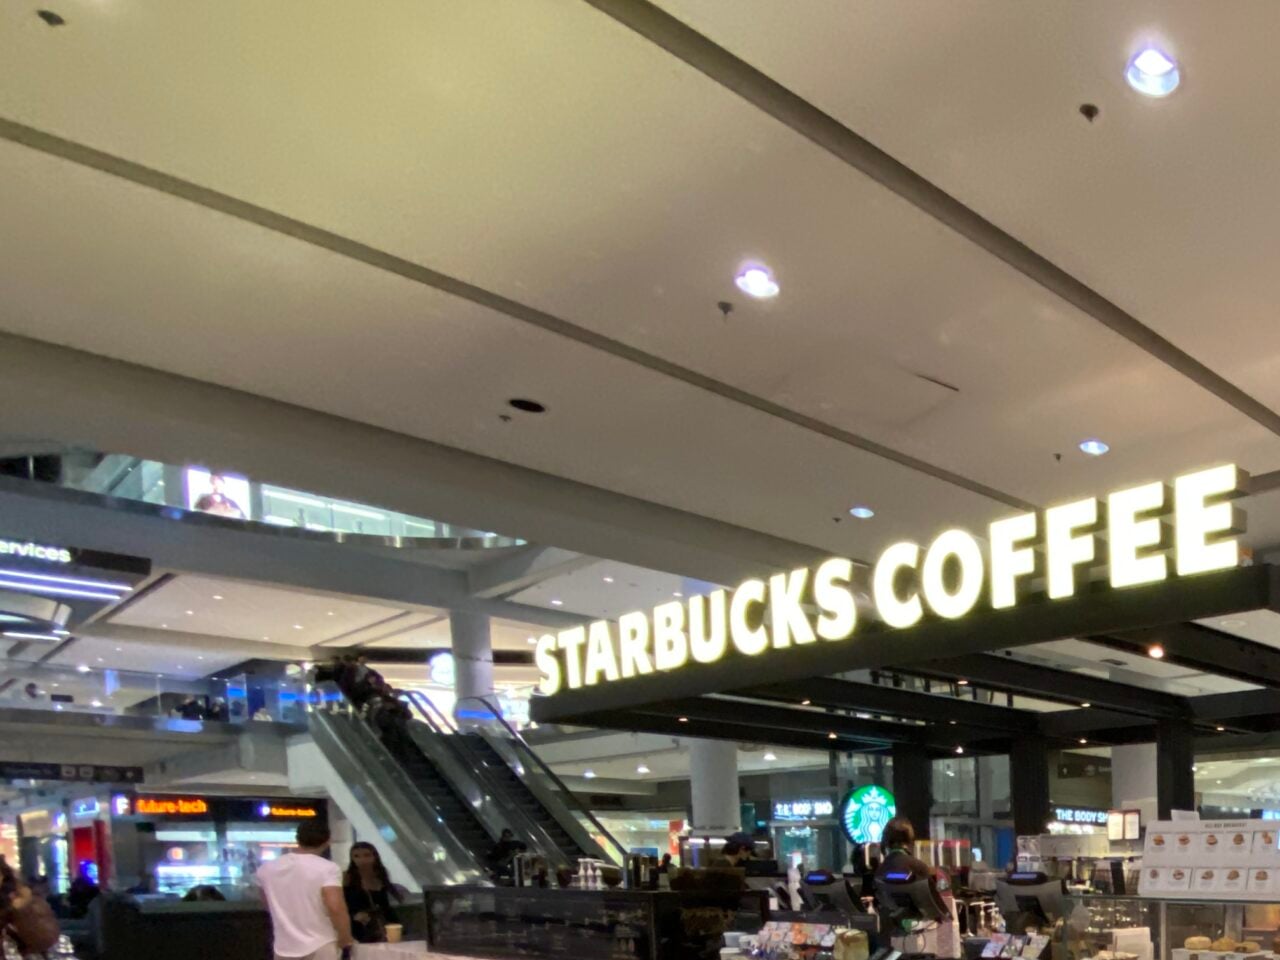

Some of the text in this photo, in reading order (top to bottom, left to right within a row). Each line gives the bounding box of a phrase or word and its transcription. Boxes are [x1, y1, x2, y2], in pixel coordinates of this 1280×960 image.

[534, 463, 1240, 697] STARBUCKS COFFEE
[1056, 808, 1073, 821] THE
[1074, 810, 1097, 822] BODY
